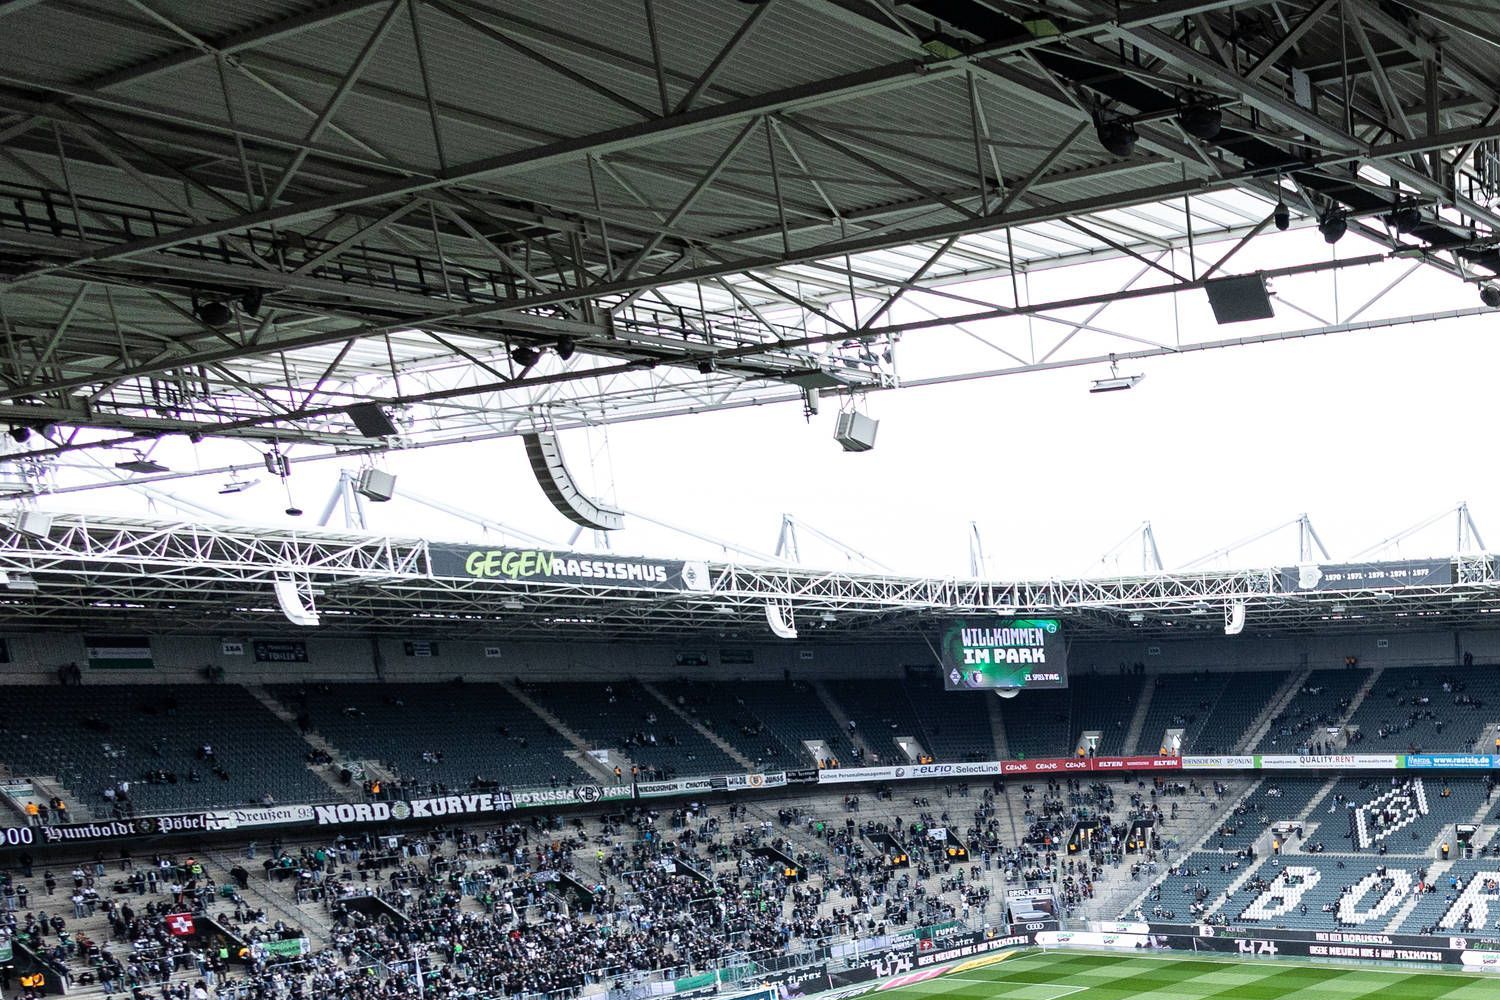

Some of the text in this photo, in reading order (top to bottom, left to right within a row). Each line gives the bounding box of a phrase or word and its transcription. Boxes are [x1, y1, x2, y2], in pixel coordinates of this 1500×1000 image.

[961, 628, 1044, 646] WILLKOMMEN
[963, 648, 1046, 664] IM PARK
[955, 765, 999, 774] SelectLine
[1005, 761, 1086, 771] cewe cewe cewe
[728, 775, 747, 786] WILDE
[838, 770, 891, 779] Personalmanagement
[514, 785, 632, 803] BORUSSIA FANS
[229, 807, 291, 823] Preußen
[315, 793, 494, 825] NORD KURVE
[44, 814, 206, 842] Humboldt Pöbel
[1343, 933, 1392, 944] BORUSSIA.
[935, 948, 961, 962] NEUEN
[1329, 946, 1360, 957] NEUEN
[1396, 949, 1442, 961] TRIKOTS!
